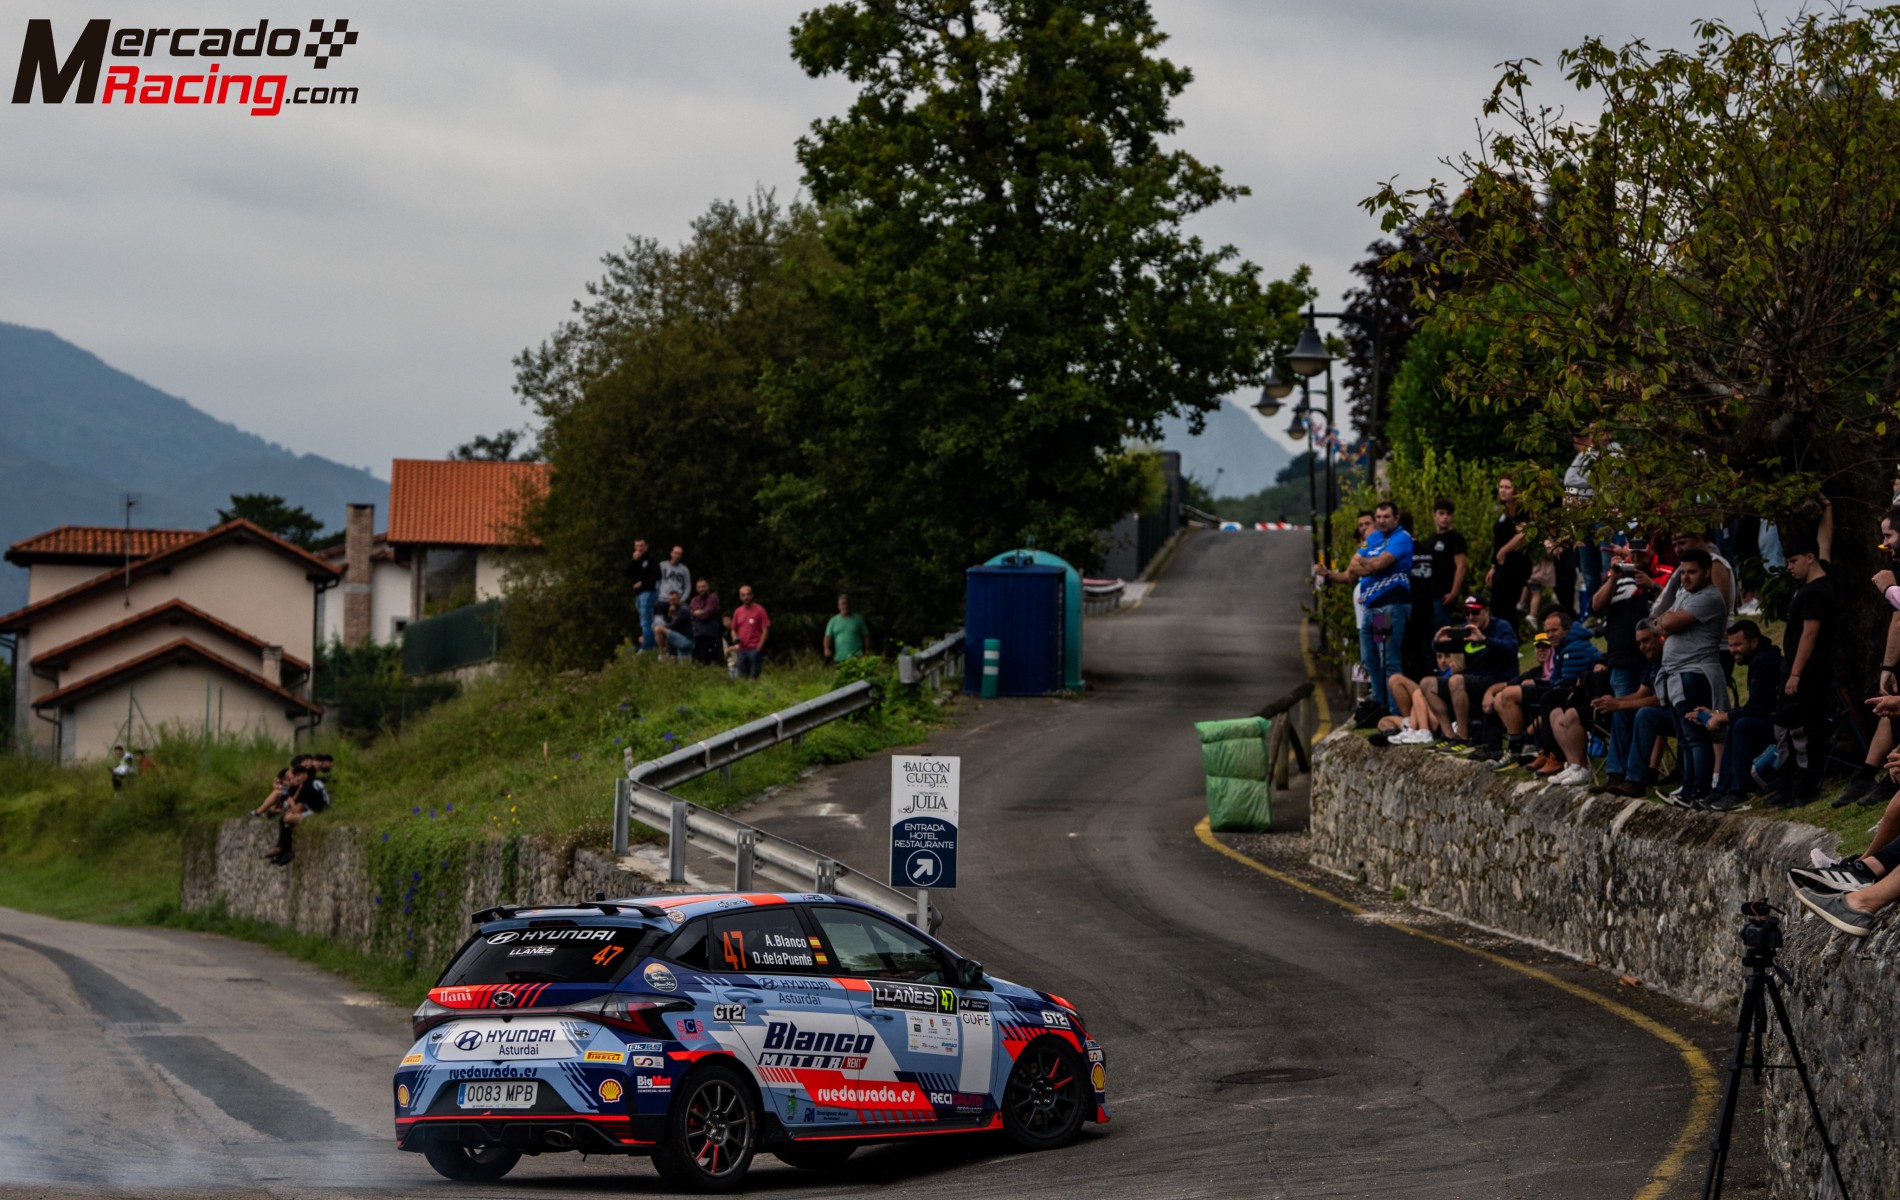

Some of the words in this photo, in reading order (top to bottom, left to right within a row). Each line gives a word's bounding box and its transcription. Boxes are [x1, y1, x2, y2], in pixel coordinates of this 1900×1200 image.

[903, 761, 950, 773] BALCÓN
[906, 773, 948, 788] CUESTA
[903, 794, 949, 814] JULIA
[904, 823, 946, 832] ENTRADA
[909, 832, 938, 840] HOTEL
[894, 840, 955, 849] RESTAURANTE
[520, 930, 617, 941] HYUNDAI
[765, 933, 808, 949] A.Blanco
[509, 944, 556, 956] LLANES
[592, 945, 624, 966] 47
[723, 931, 747, 970] 47
[752, 951, 814, 967] D.delaPuente
[779, 979, 832, 991] HYUNDAI
[778, 992, 823, 1006] Asturdai
[875, 985, 936, 1006] LLANES
[940, 989, 955, 1011] 47
[713, 1003, 746, 1020] GT2i
[676, 1018, 704, 1034] SCS
[485, 1029, 556, 1043] HYUNDAI
[763, 1021, 876, 1054] Blanco
[498, 1043, 539, 1056] Asturdai
[586, 1051, 622, 1061] PIRELLI
[760, 1053, 843, 1069] MOTOR
[846, 1057, 863, 1069] RENT
[449, 1064, 538, 1080] ruedausada.es
[637, 1074, 672, 1088] BigMat
[467, 1085, 501, 1102] 0083
[505, 1084, 534, 1102] MPB
[817, 1085, 916, 1103] ruedausada.es
